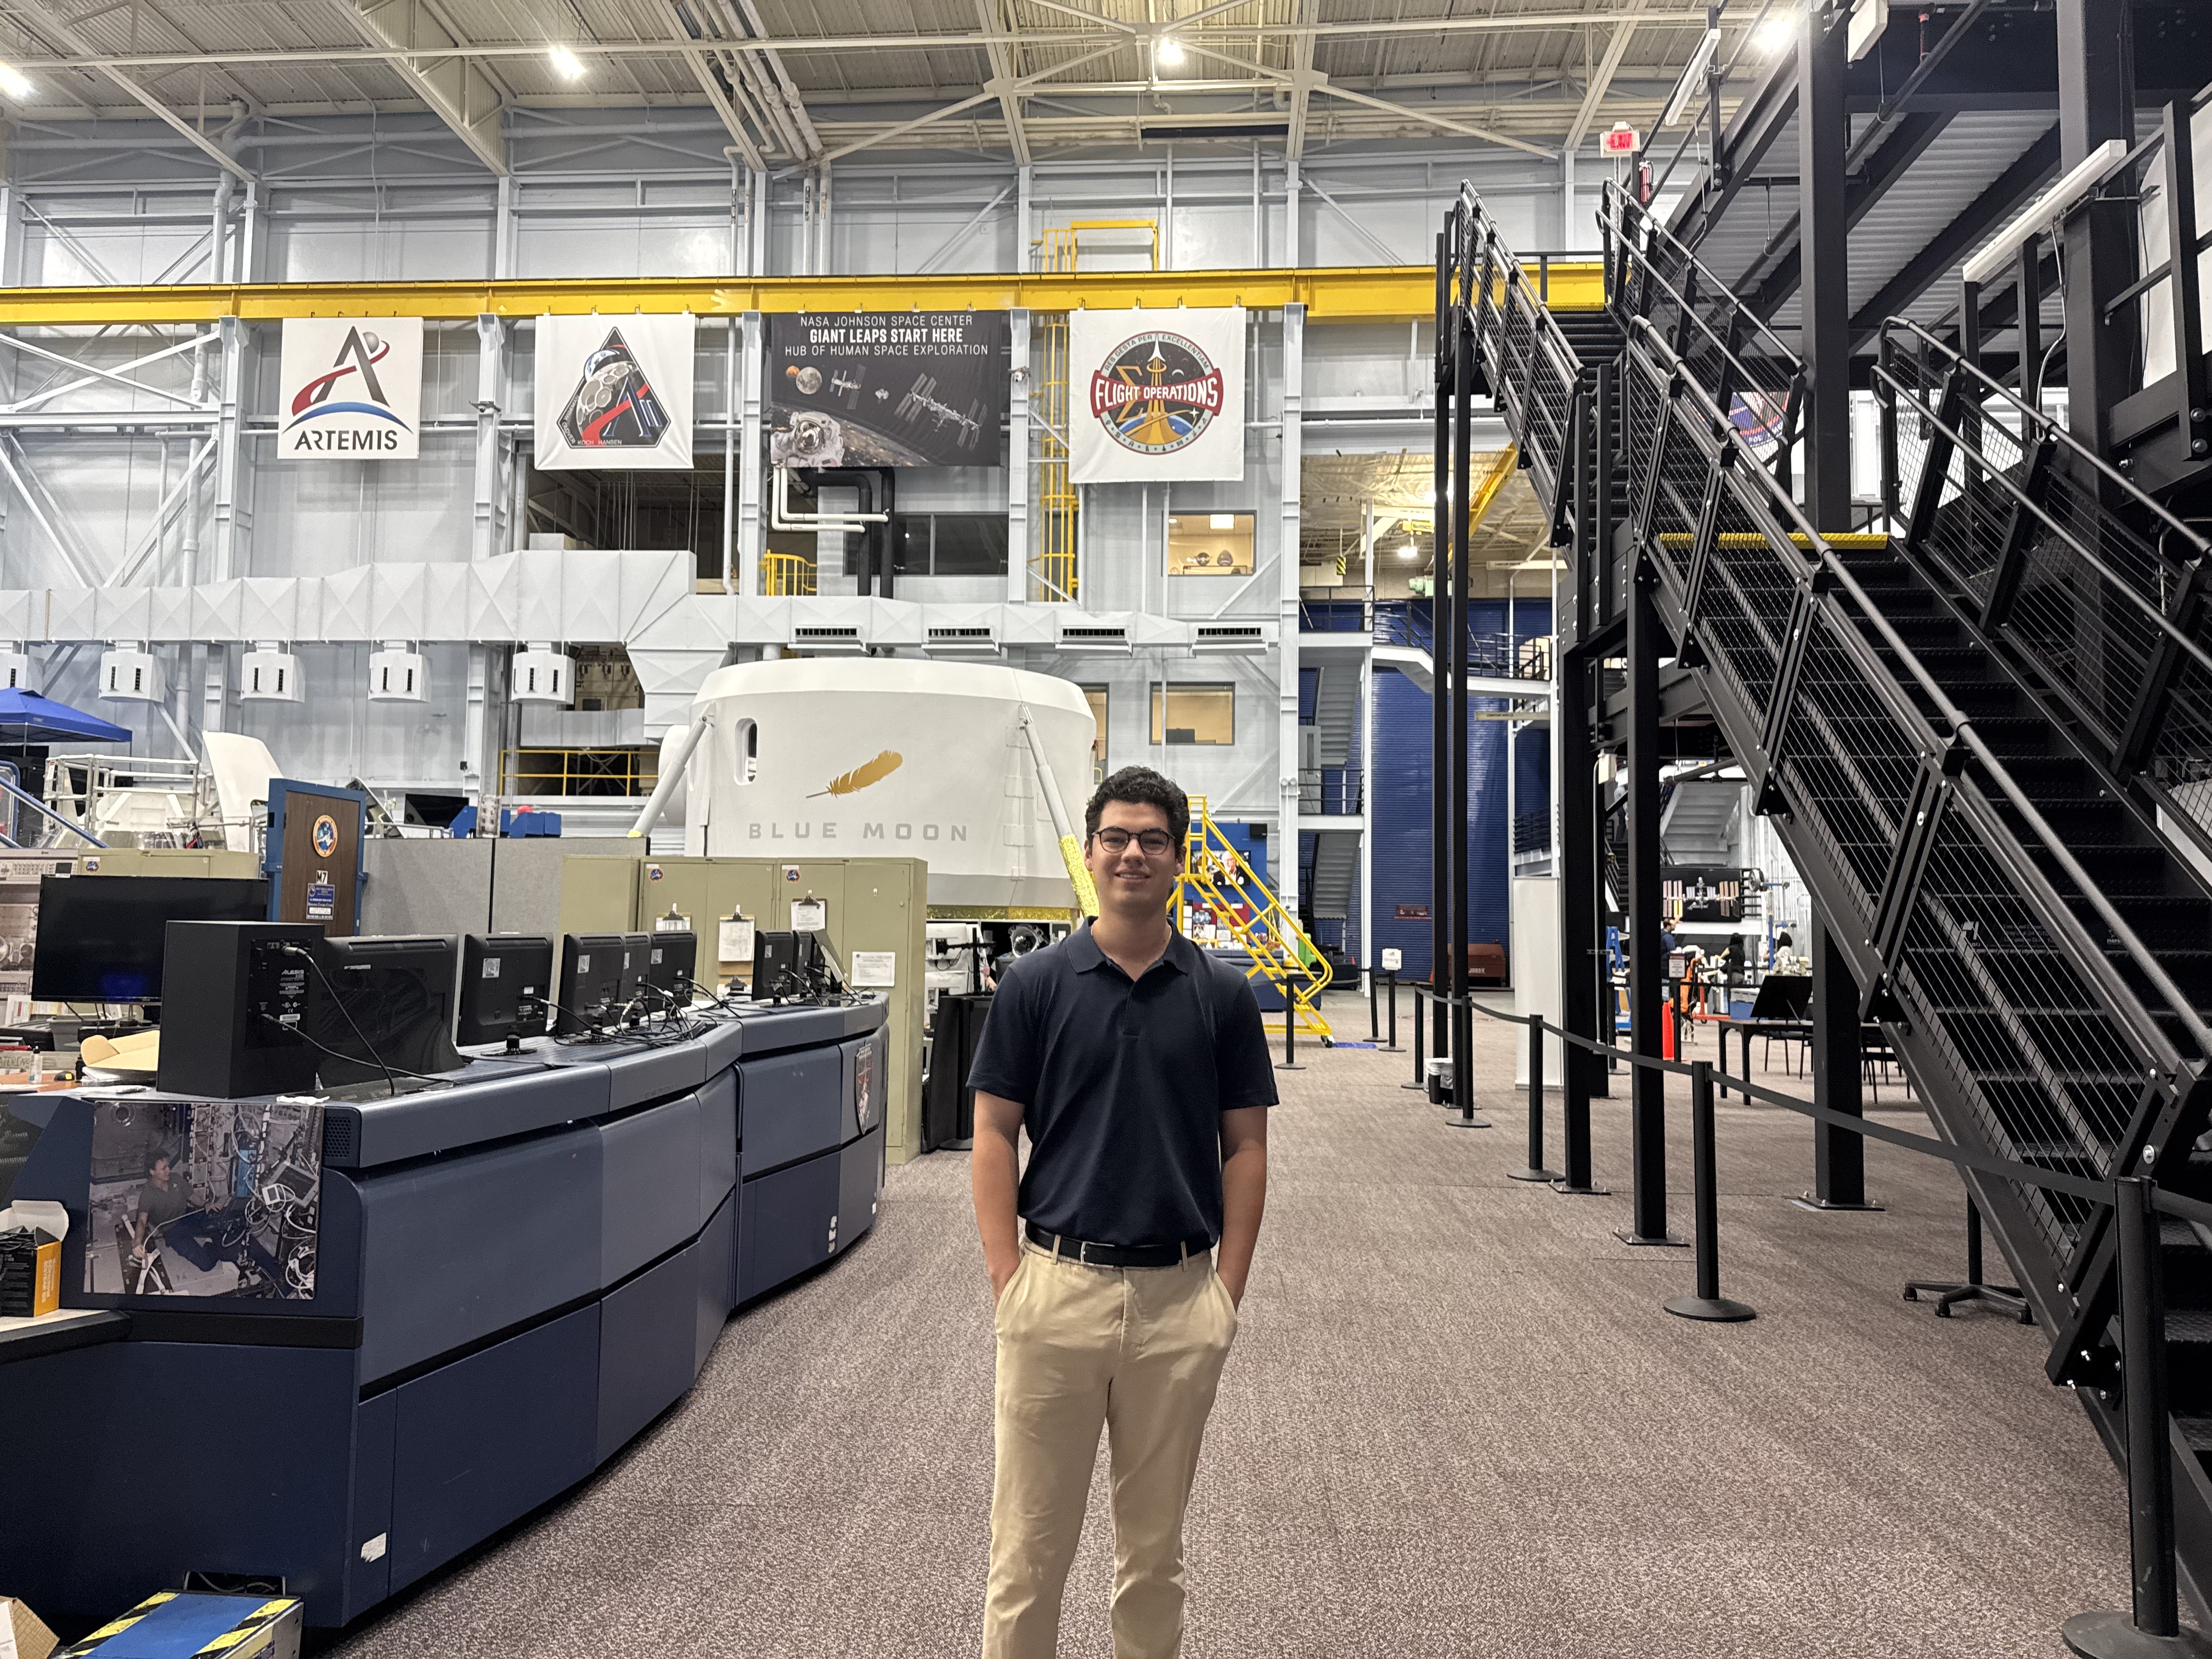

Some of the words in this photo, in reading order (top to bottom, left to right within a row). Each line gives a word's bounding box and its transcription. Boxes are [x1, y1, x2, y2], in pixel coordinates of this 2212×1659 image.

[1611, 133, 1632, 150] EXIT
[800, 316, 830, 327] NASA
[834, 315, 887, 327] JOHNSON
[890, 315, 926, 326] SPACE
[930, 315, 973, 326] CENTER
[810, 329, 846, 343] GIANT
[850, 329, 887, 343] LEAPS
[890, 329, 928, 343] START
[933, 328, 963, 342] HERE
[785, 346, 807, 356] HUB
[812, 346, 825, 356] OF
[830, 345, 868, 356] HUMAN
[874, 345, 909, 356] SPACE
[913, 345, 988, 356] EXPLORATION
[1104, 357, 1116, 371] RES
[1115, 340, 1136, 356] GESTA
[1138, 334, 1153, 343] PER
[1161, 334, 1210, 369] EXCELLENTIAM
[1096, 378, 1140, 410] FLIGHT
[1143, 377, 1218, 407] OPERATIONS
[294, 430, 398, 450] ARTEMIS
[562, 422, 575, 444] GLOVER
[749, 822, 837, 839] BLUE
[862, 822, 967, 842] MOON
[317, 871, 327, 883] M7
